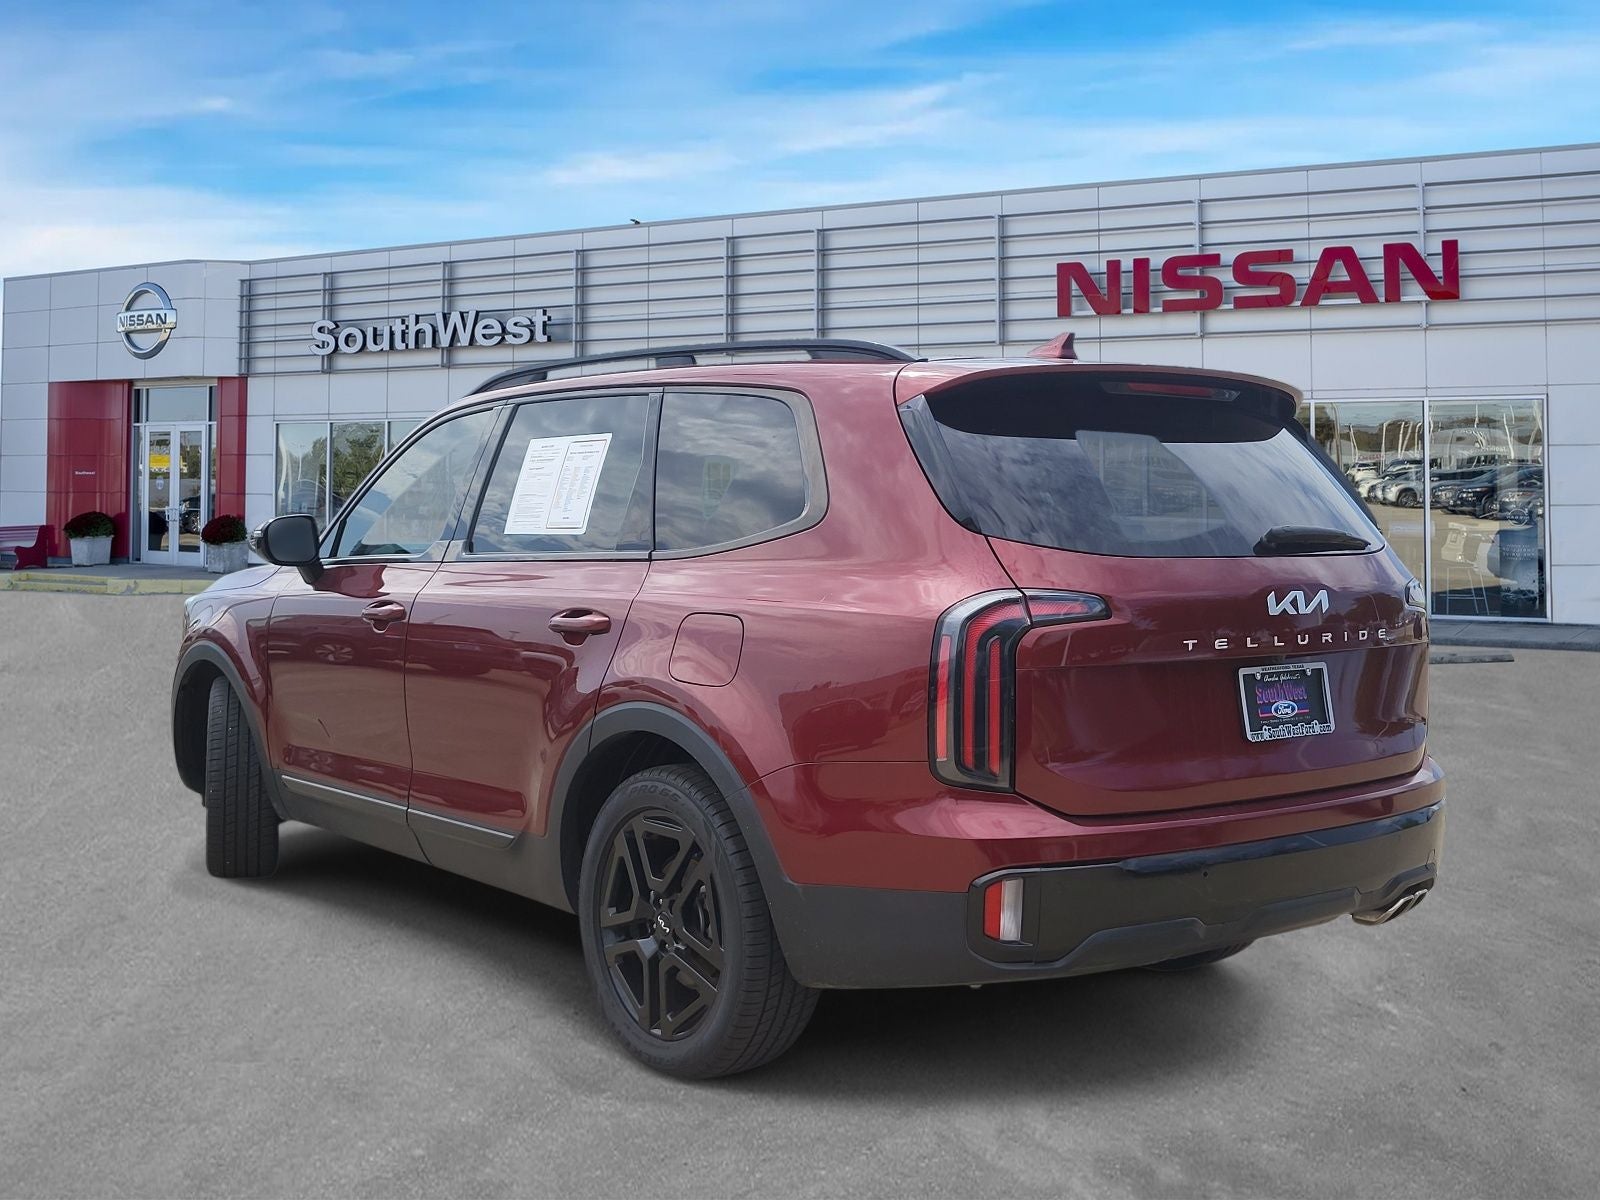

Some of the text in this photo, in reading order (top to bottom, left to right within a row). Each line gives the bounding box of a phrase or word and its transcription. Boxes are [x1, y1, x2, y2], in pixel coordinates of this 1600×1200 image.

[1056, 239, 1460, 317] NISSAN
[119, 312, 167, 328] NISSAN
[309, 308, 552, 356] SouthWest
[1266, 590, 1330, 616] KIA
[1183, 628, 1386, 651] TELLURIDE
[1255, 682, 1308, 704] SouthWest
[1277, 703, 1292, 714] Ford
